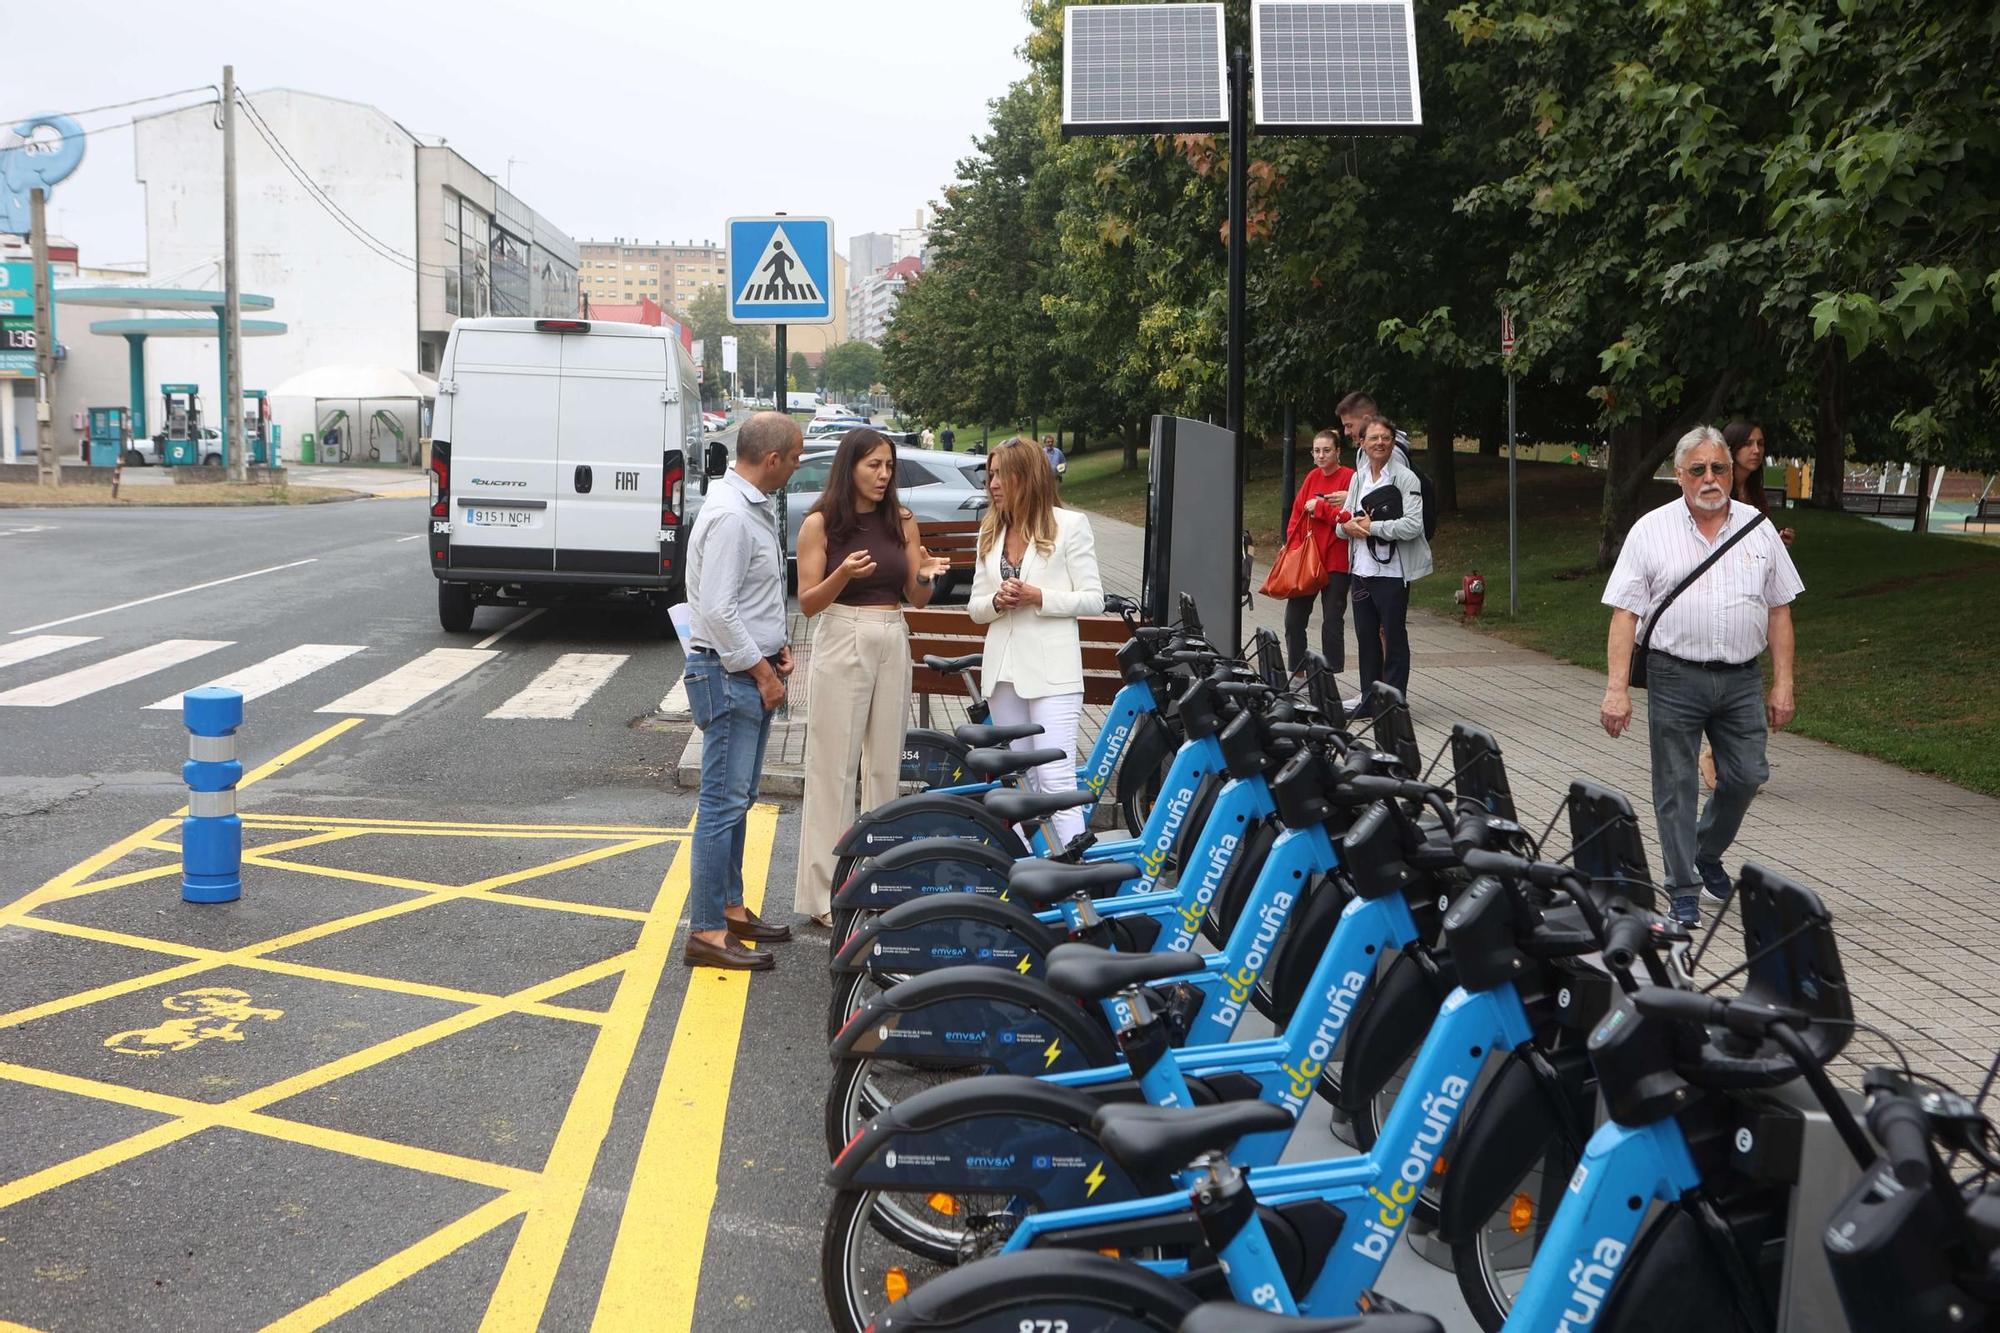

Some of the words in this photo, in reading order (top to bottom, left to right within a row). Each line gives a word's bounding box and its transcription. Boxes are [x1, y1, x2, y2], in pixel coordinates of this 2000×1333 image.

[475, 511, 504, 523] 9151
[508, 512, 531, 524] NCH
[615, 471, 640, 491] FIAT
[1167, 833, 1239, 953] bicicoruña
[1211, 890, 1294, 1029] bicicoruña
[1352, 1074, 1470, 1263] bicicoruña
